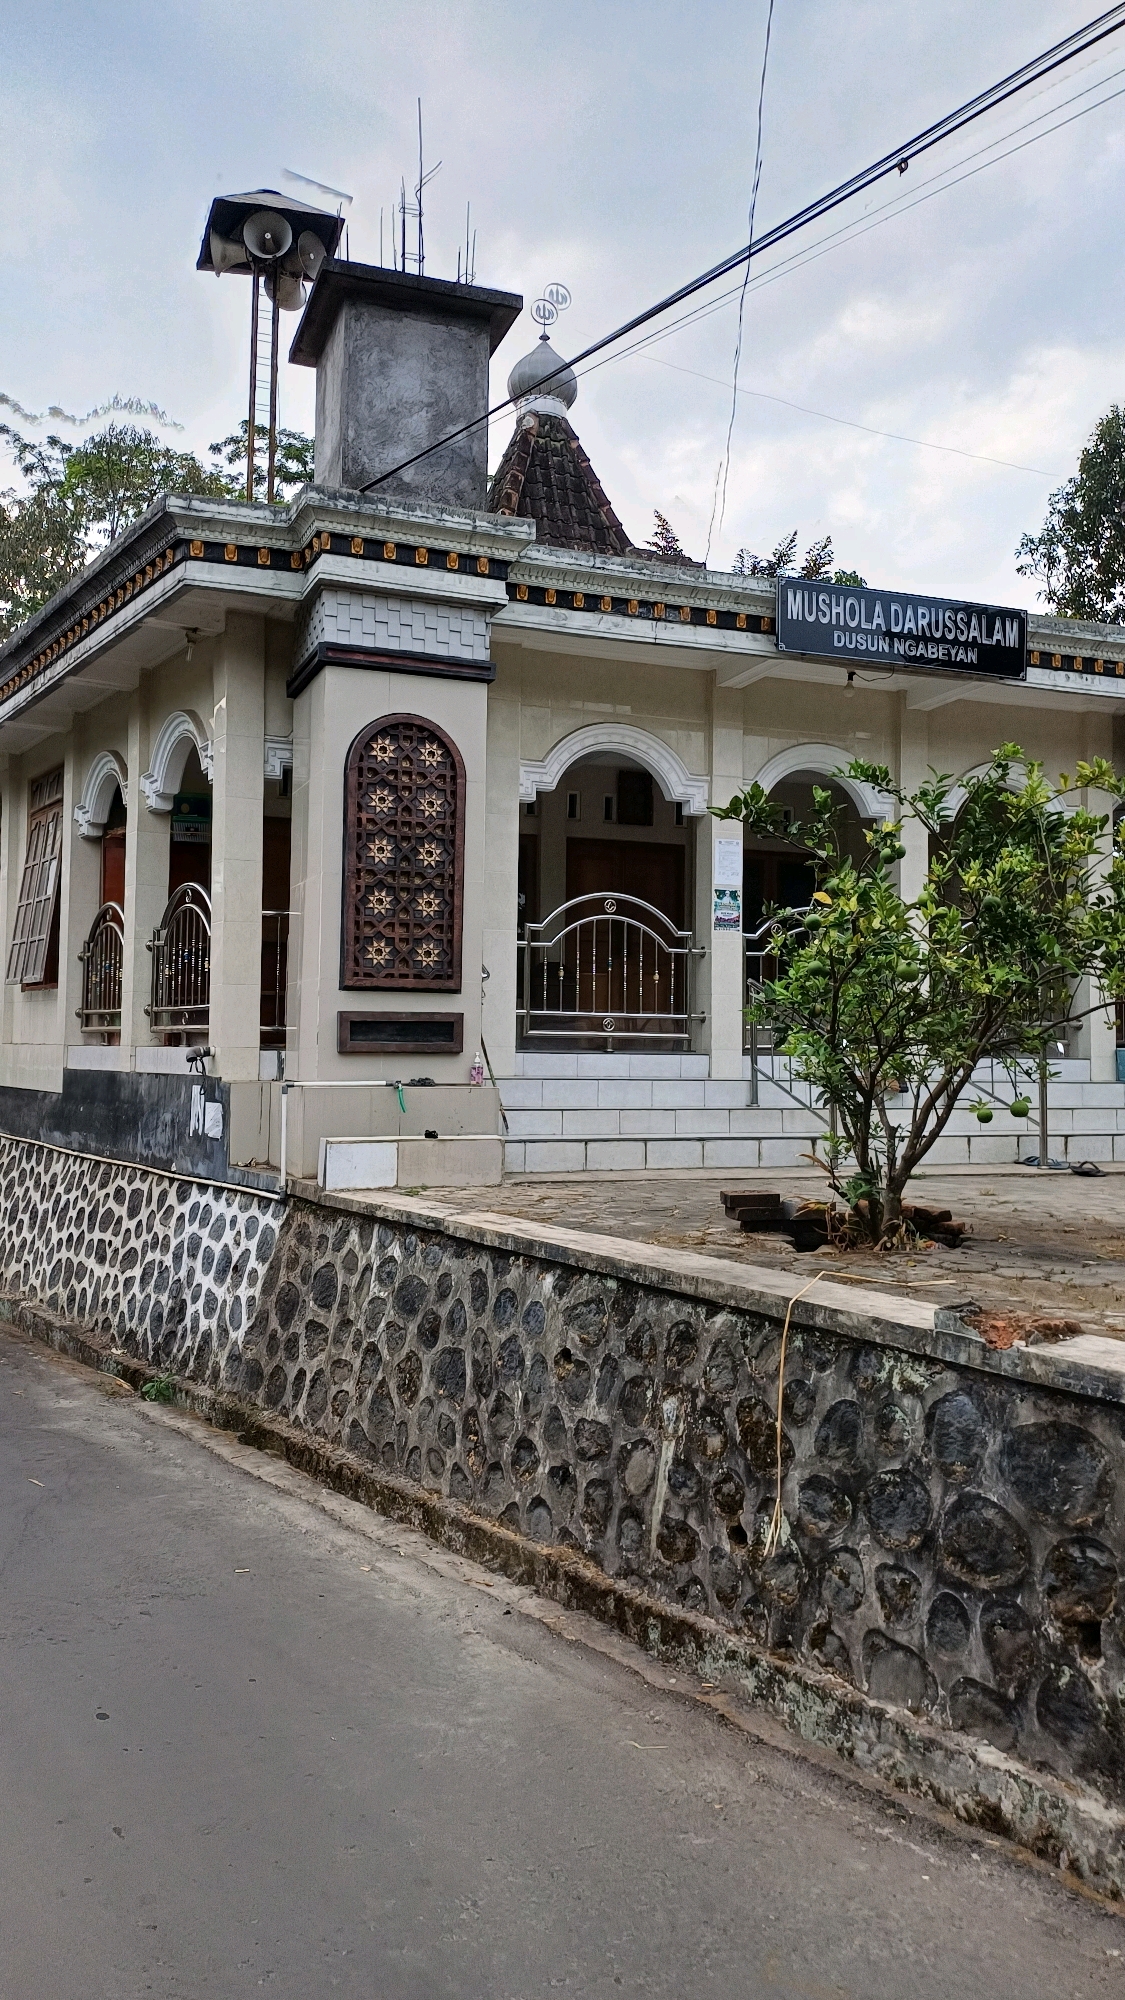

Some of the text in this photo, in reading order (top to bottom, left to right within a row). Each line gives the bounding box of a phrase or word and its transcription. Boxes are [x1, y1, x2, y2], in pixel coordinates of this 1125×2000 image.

[787, 588, 1019, 648] MUSHOLA DARUSSALAM
[833, 630, 978, 664] DUSUN NGABEYAN
